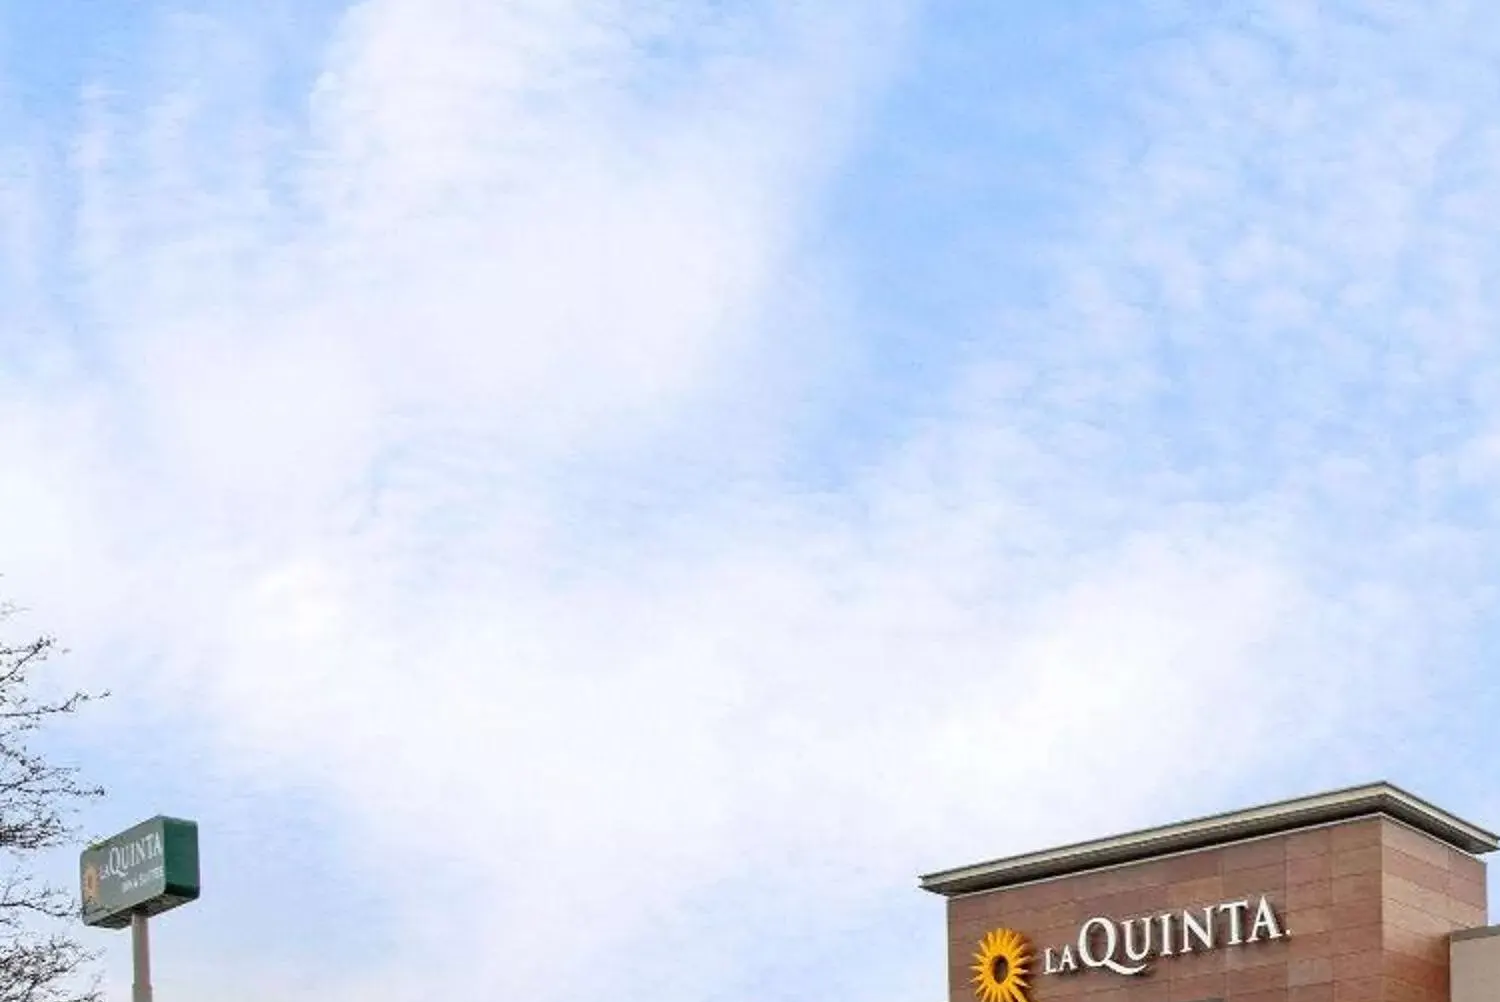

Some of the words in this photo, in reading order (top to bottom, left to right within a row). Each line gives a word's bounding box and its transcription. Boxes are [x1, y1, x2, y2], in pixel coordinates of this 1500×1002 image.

[109, 832, 162, 877] QUINTA
[1043, 944, 1078, 975] LA
[1078, 896, 1283, 975] QUINTA
